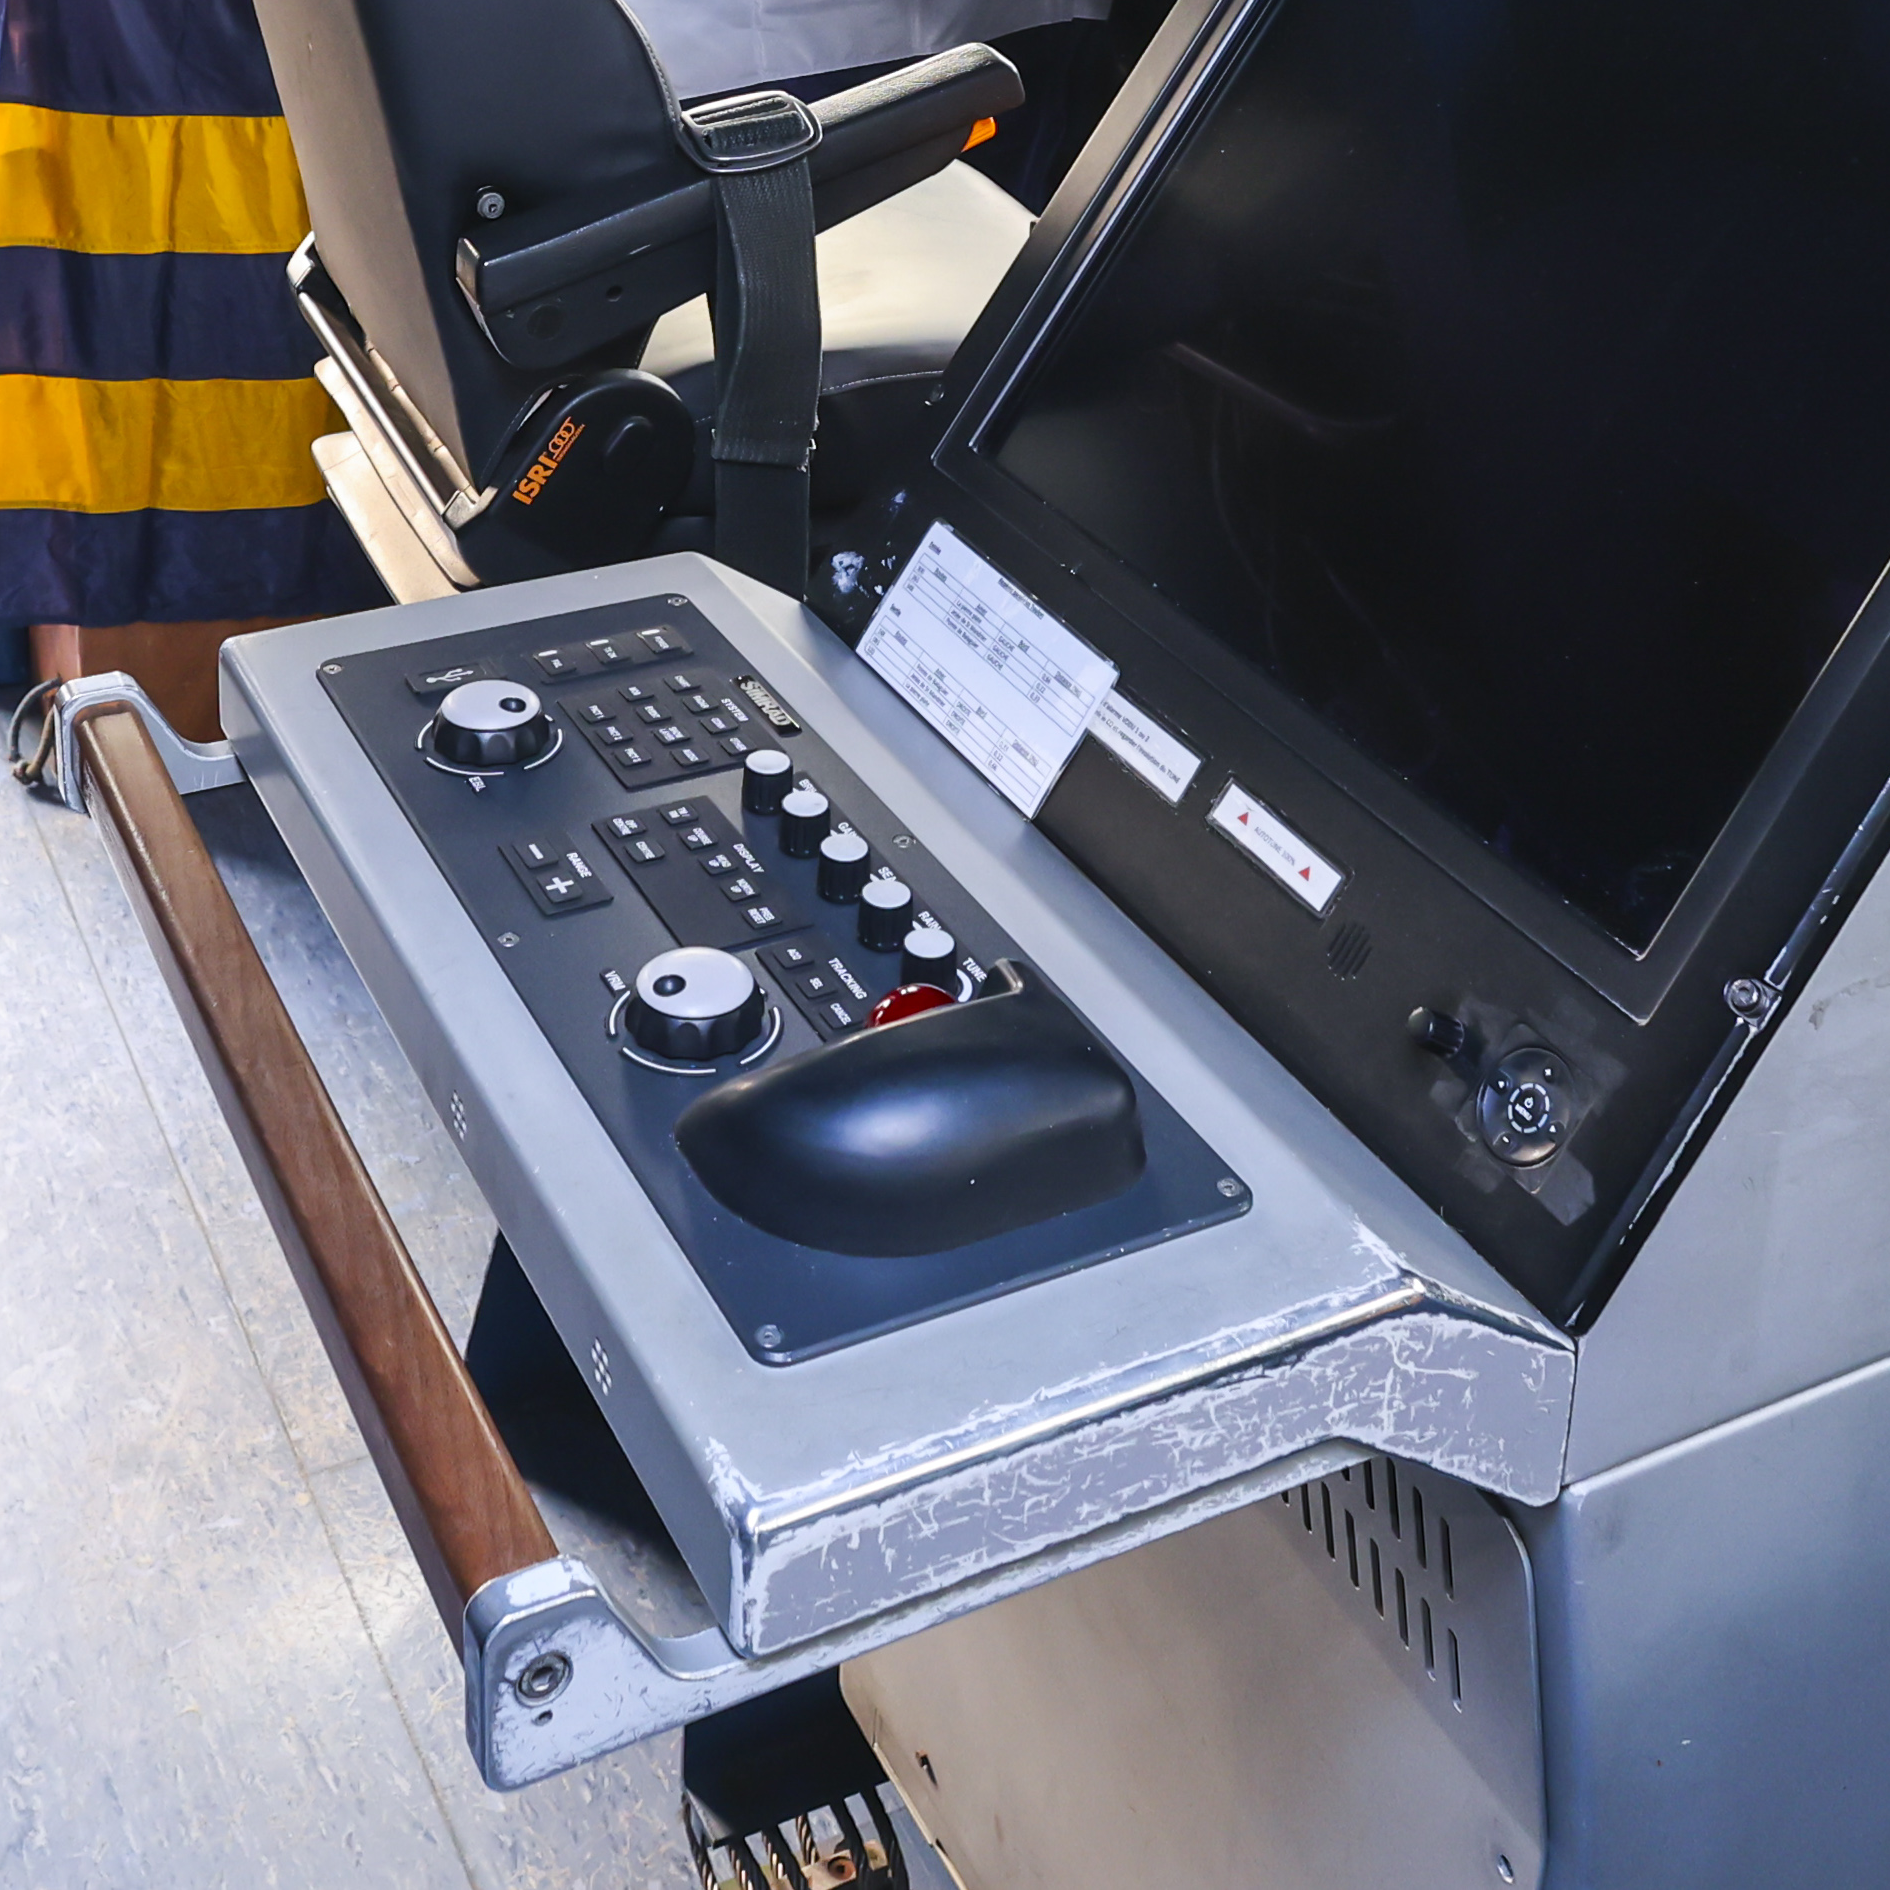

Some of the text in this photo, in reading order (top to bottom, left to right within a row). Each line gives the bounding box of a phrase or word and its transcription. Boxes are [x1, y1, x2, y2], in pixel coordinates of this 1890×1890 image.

[512, 455, 558, 505] ISRI
[721, 698, 749, 722] SYSTEM
[740, 680, 792, 726] SIMRAD
[468, 776, 487, 793] EBL
[1253, 826, 1283, 853] AUTOTUNE
[566, 852, 593, 878] RANGE
[733, 843, 764, 872] DISPLAY
[604, 969, 626, 991] VRM
[828, 958, 868, 1000] TRACKING
[962, 957, 988, 982] TUNE
[830, 1002, 852, 1026] CANCEL
